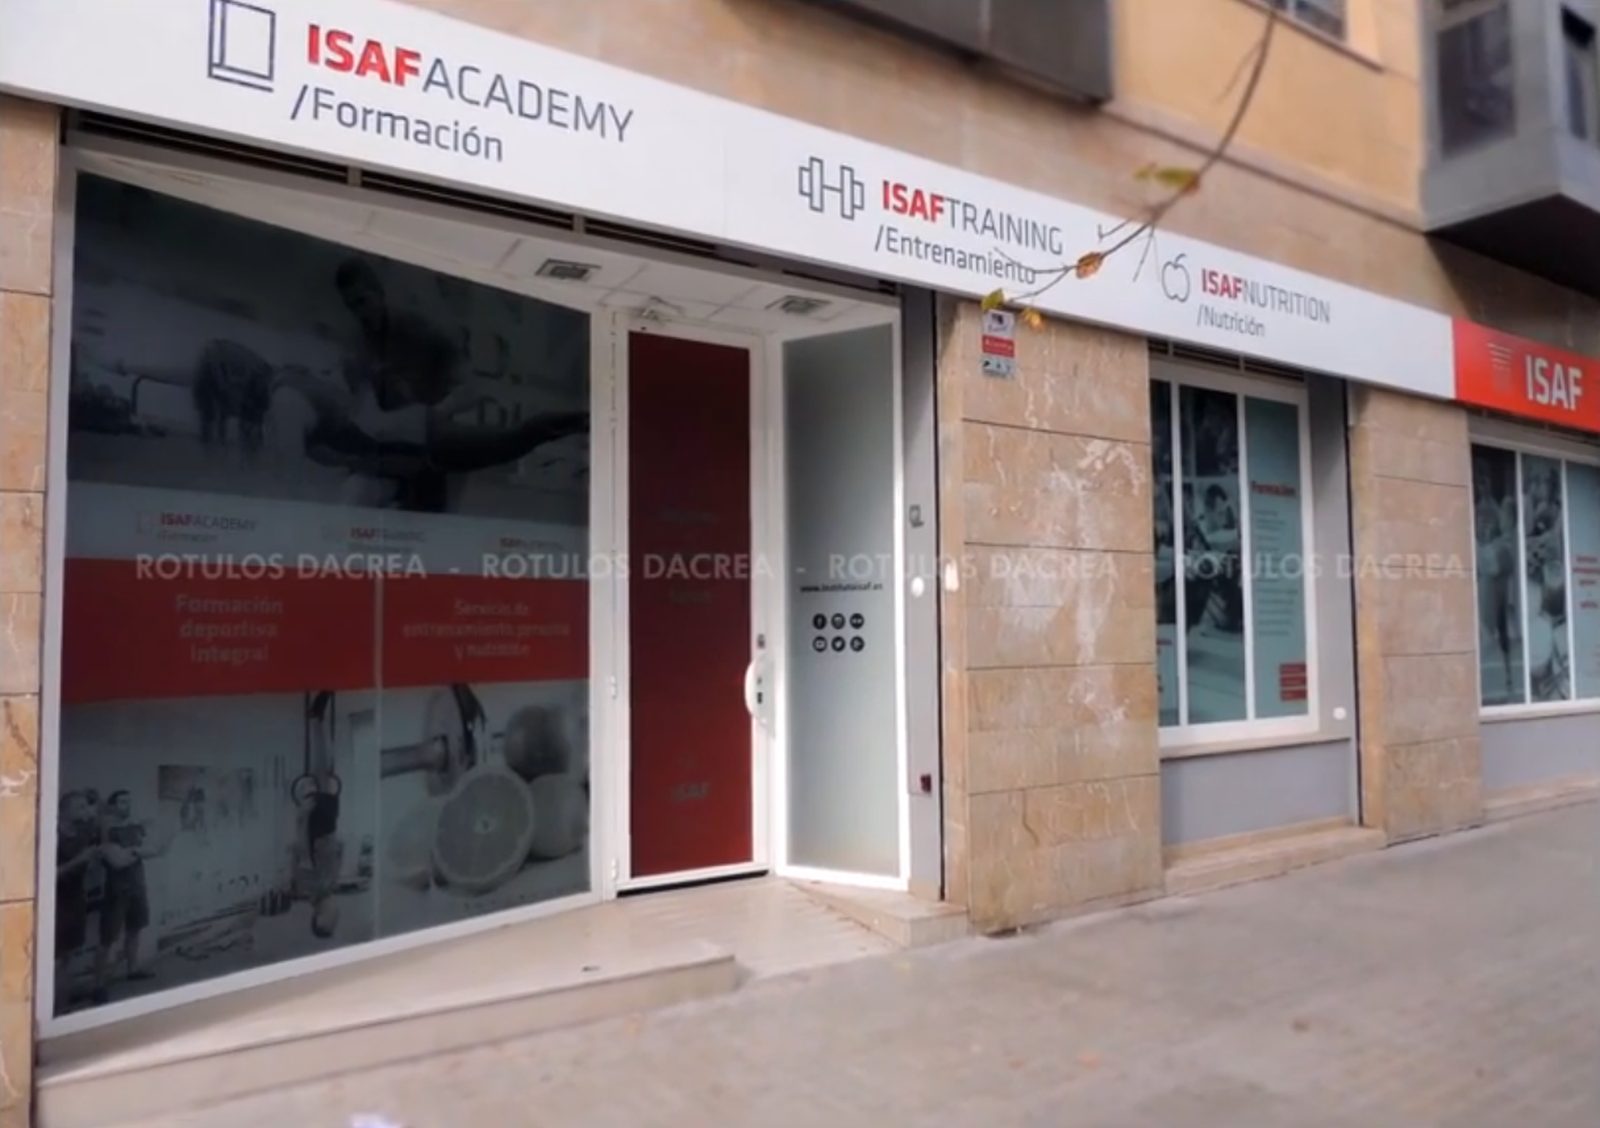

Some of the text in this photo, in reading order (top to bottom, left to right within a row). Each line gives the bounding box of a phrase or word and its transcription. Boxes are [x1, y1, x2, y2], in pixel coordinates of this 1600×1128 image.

[307, 23, 634, 143] ISAFACADEMY
[290, 84, 503, 162] /Formación
[882, 180, 1064, 255] ISAFTRAINING
[1201, 268, 1331, 324] ISAFNUTRITION
[1525, 354, 1583, 411] ISAF
[175, 593, 285, 615] Formación
[179, 619, 279, 644] deportiva
